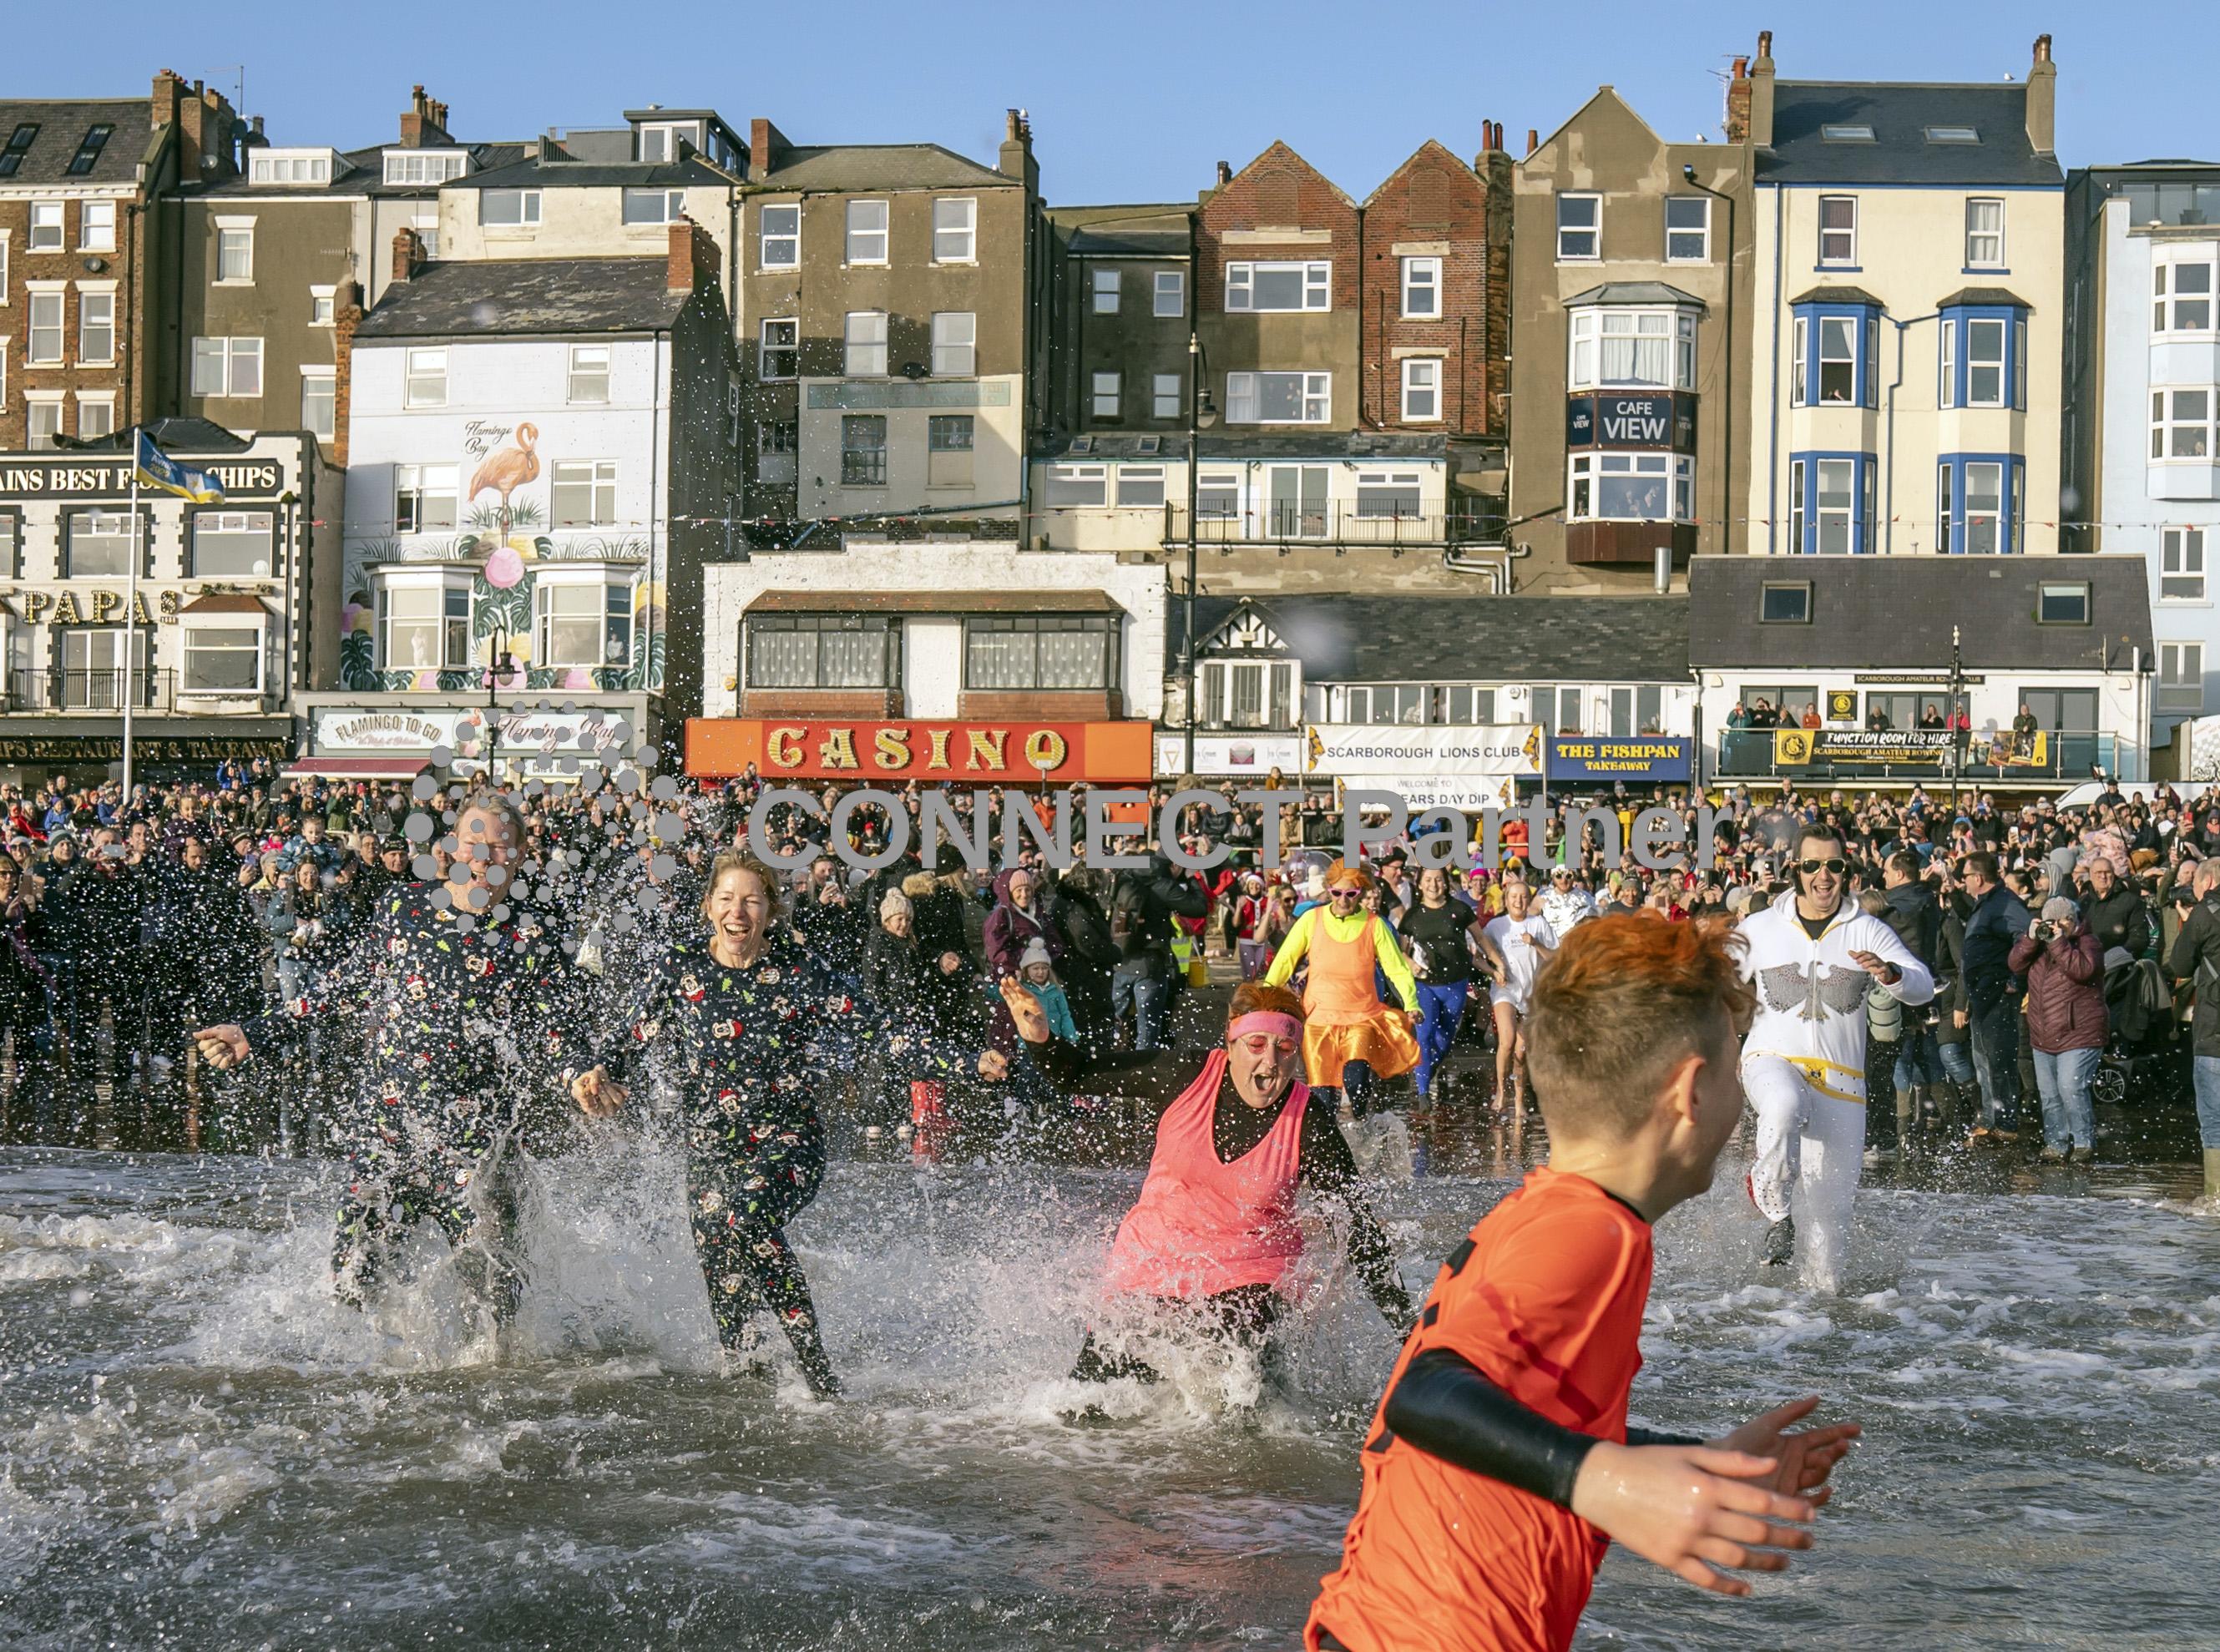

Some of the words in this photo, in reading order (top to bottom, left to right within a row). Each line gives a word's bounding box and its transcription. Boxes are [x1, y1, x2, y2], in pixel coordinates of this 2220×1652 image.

[1616, 402, 1652, 415] CAFE
[1573, 419, 1590, 429] VIEW
[1603, 417, 1666, 440] VIEW
[465, 420, 513, 444] Flamingo
[465, 437, 489, 462] Bay
[49, 468, 110, 491] BEST
[23, 589, 177, 624] PAPAS
[336, 715, 402, 740] FLAMINGO
[406, 716, 421, 733] TO
[422, 723, 442, 742] GO
[1827, 733, 1879, 745] FUNCTION
[1879, 733, 1906, 745] ROOM
[1908, 733, 1925, 744] FOR
[1927, 733, 1952, 745] HIRE
[168, 741, 181, 758] &
[187, 741, 287, 758] TAKEAWAY
[767, 727, 1066, 770] CASINO
[1327, 746, 1433, 759] SCARBOROUGH
[1440, 746, 1479, 758] LIONS
[1484, 746, 1520, 758] CLUB
[1557, 745, 1595, 758] THE
[1601, 745, 1681, 759] FISHPAN
[1813, 747, 1873, 755] SCARBOROUGH
[1873, 748, 1910, 756] AMATEUR
[1585, 760, 1651, 771] TAKEAWAY
[1397, 780, 1439, 788] WELCOME
[1402, 794, 1434, 805] EARS
[1439, 794, 1465, 805] DAY
[1469, 793, 1489, 804] DIP
